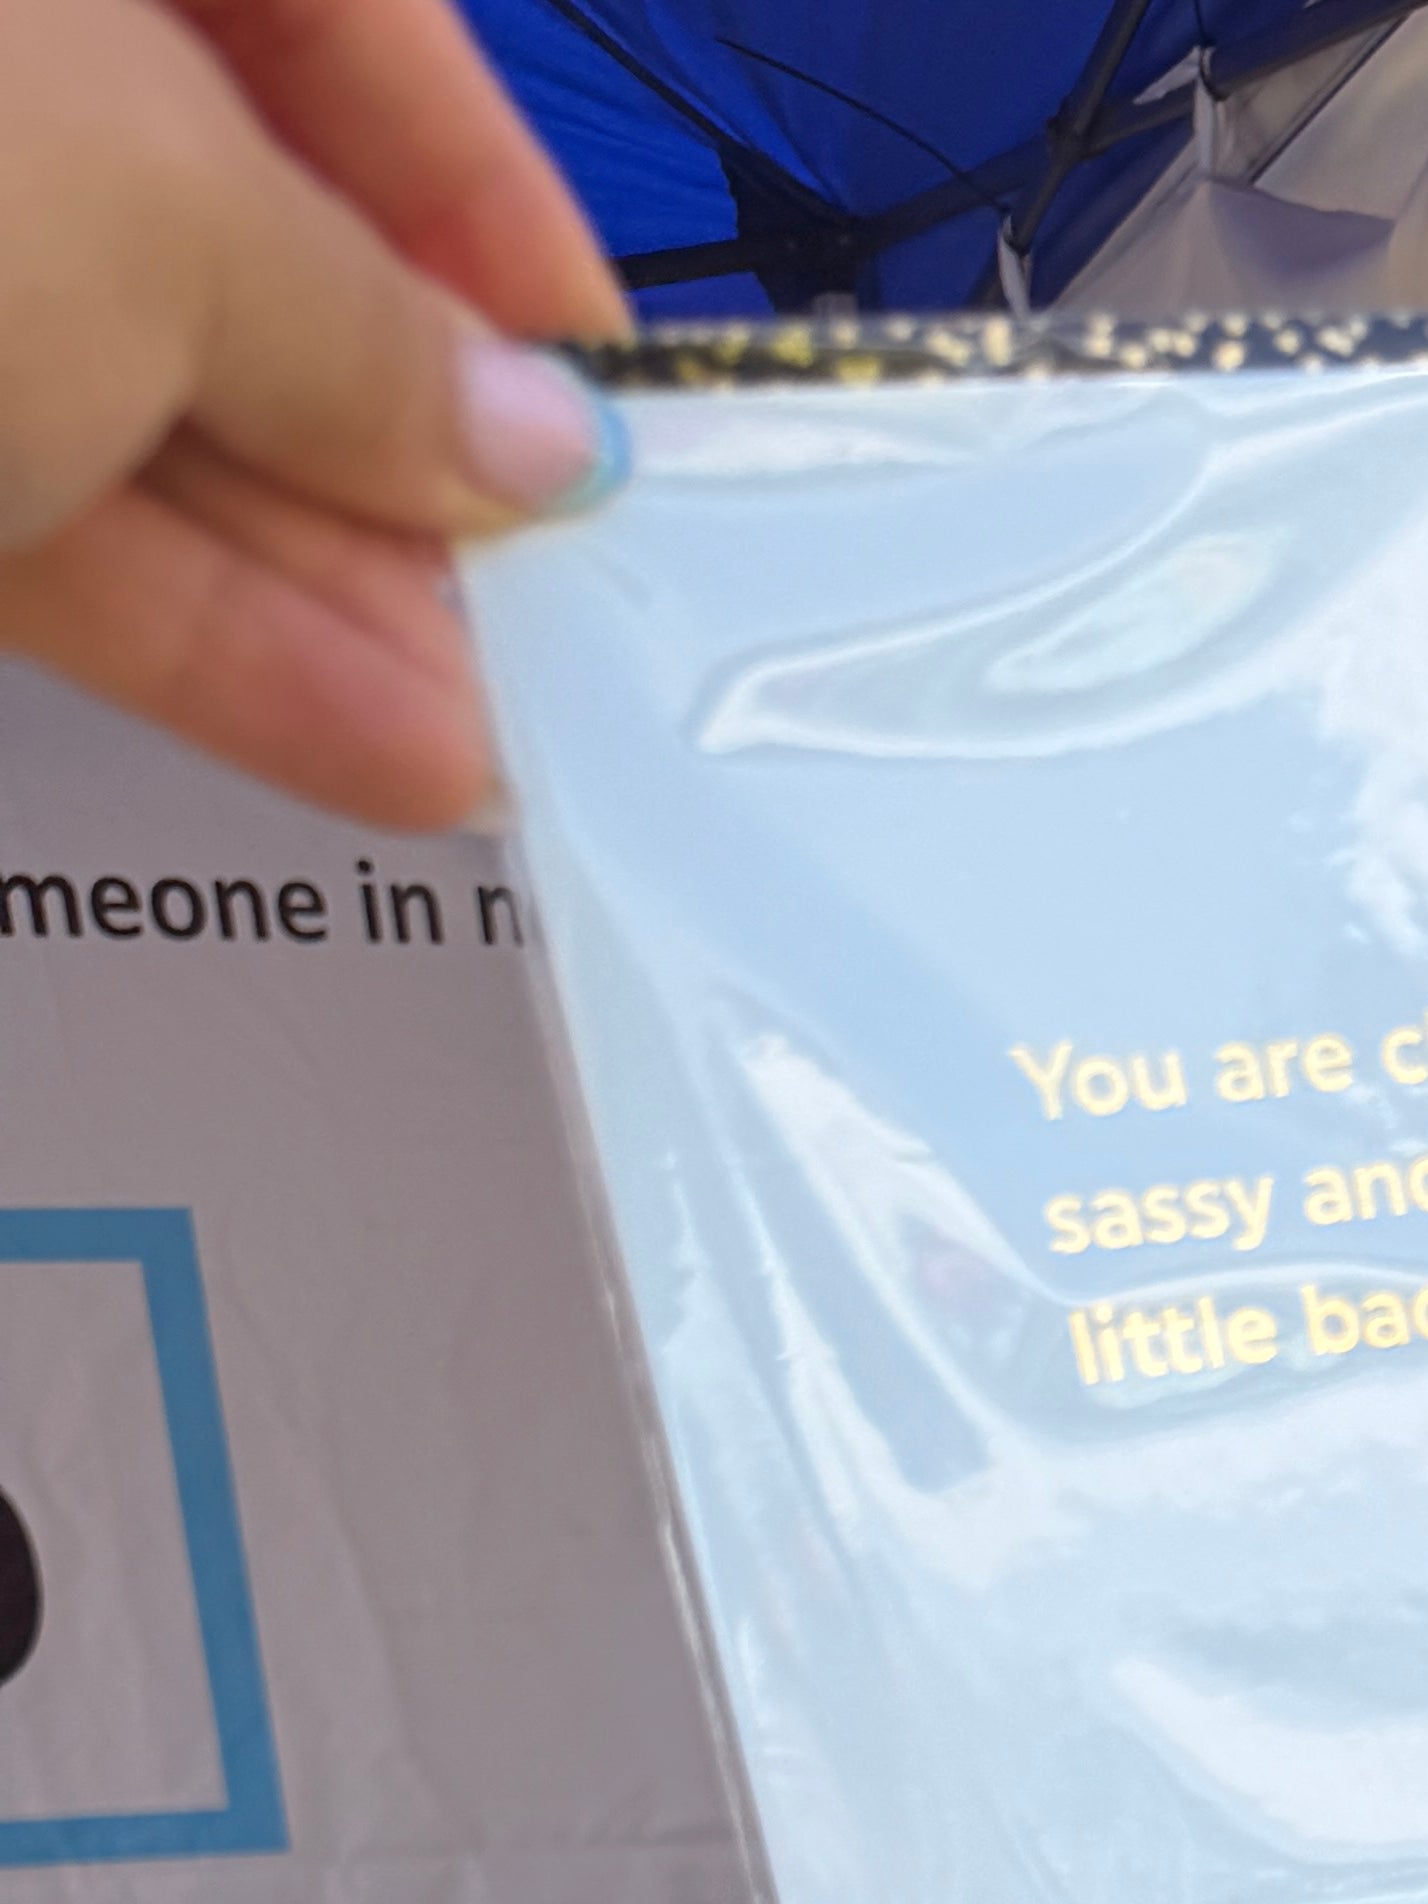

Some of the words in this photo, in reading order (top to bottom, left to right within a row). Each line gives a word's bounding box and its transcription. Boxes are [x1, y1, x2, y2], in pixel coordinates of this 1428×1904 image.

[354, 857, 444, 944] in
[1009, 1042, 1189, 1120] You
[1215, 1034, 1353, 1102] are
[1043, 1173, 1275, 1255] sassy
[1068, 1297, 1279, 1386] little
